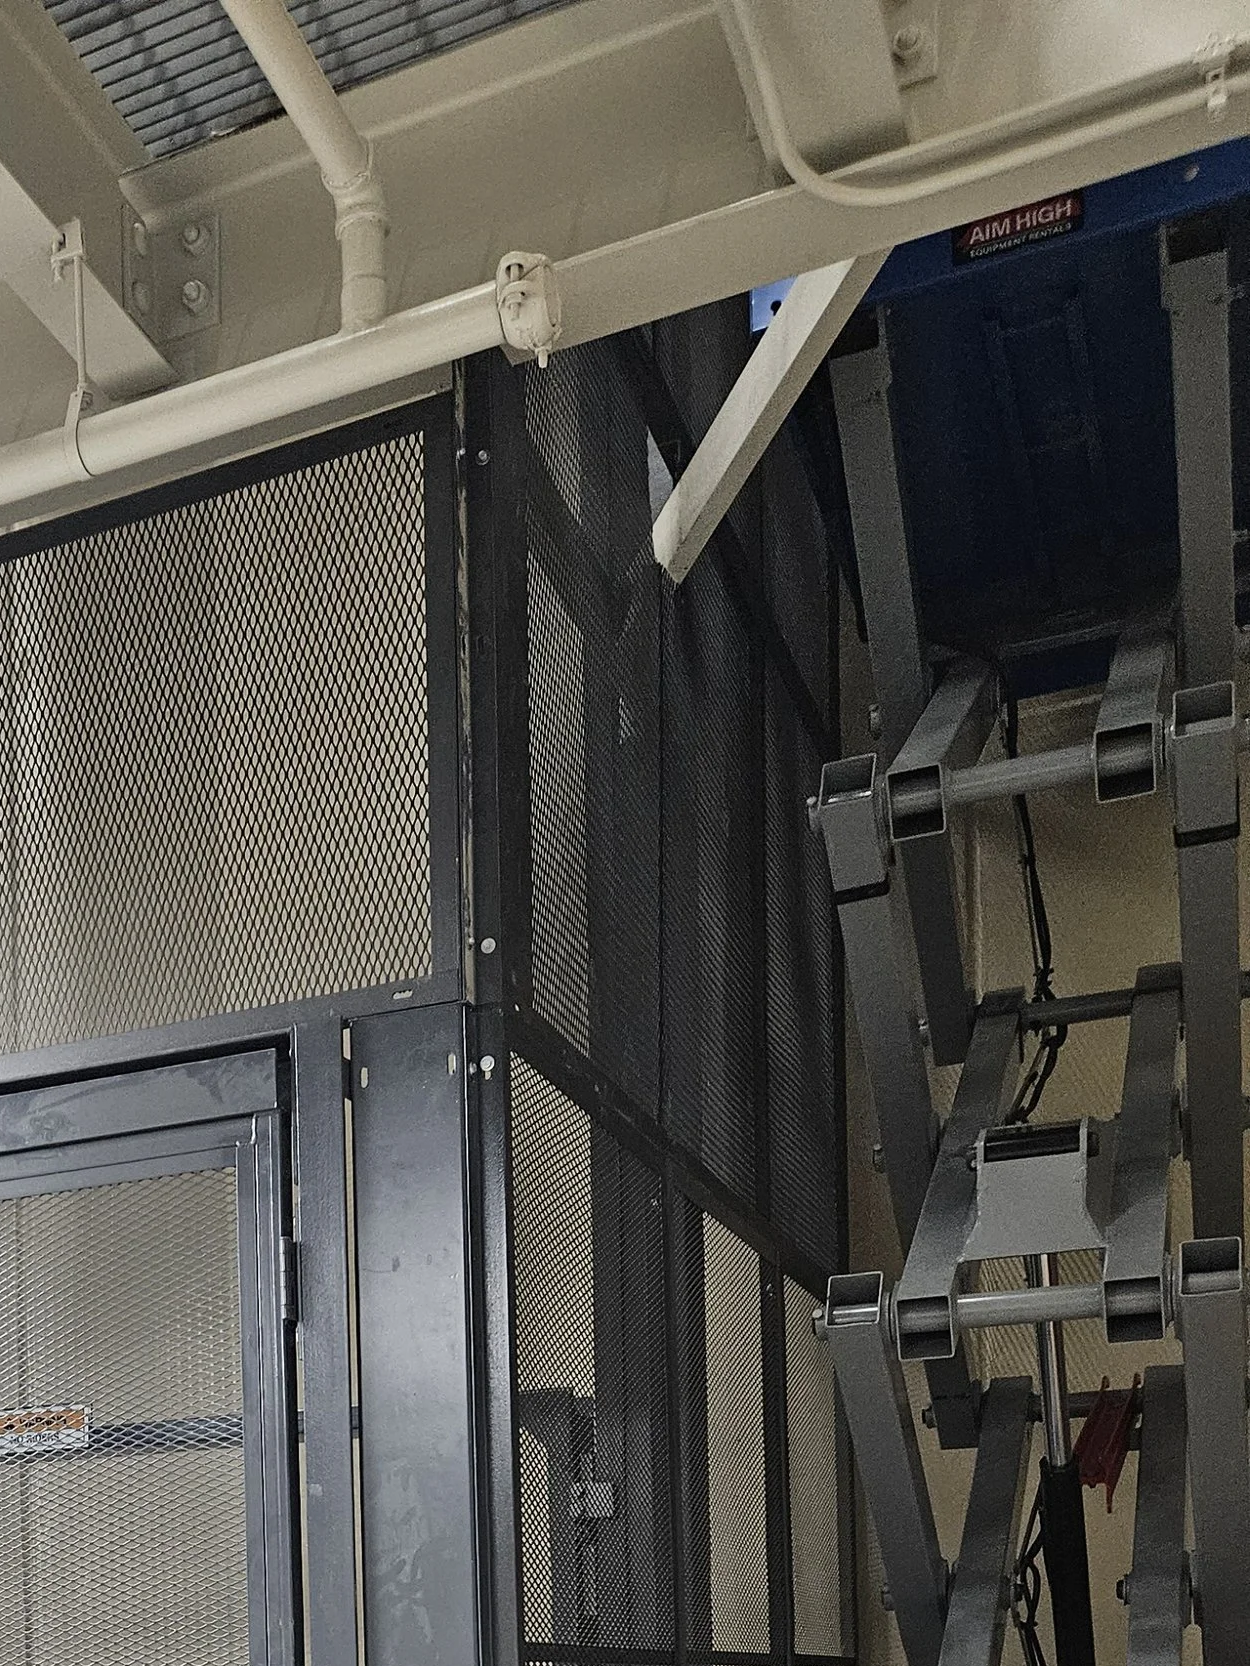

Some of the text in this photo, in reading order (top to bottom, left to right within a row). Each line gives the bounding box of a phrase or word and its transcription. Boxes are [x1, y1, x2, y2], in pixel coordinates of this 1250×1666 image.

[969, 199, 1071, 244] AIM HIGH
[970, 235, 1026, 258] EQUIPMENT
